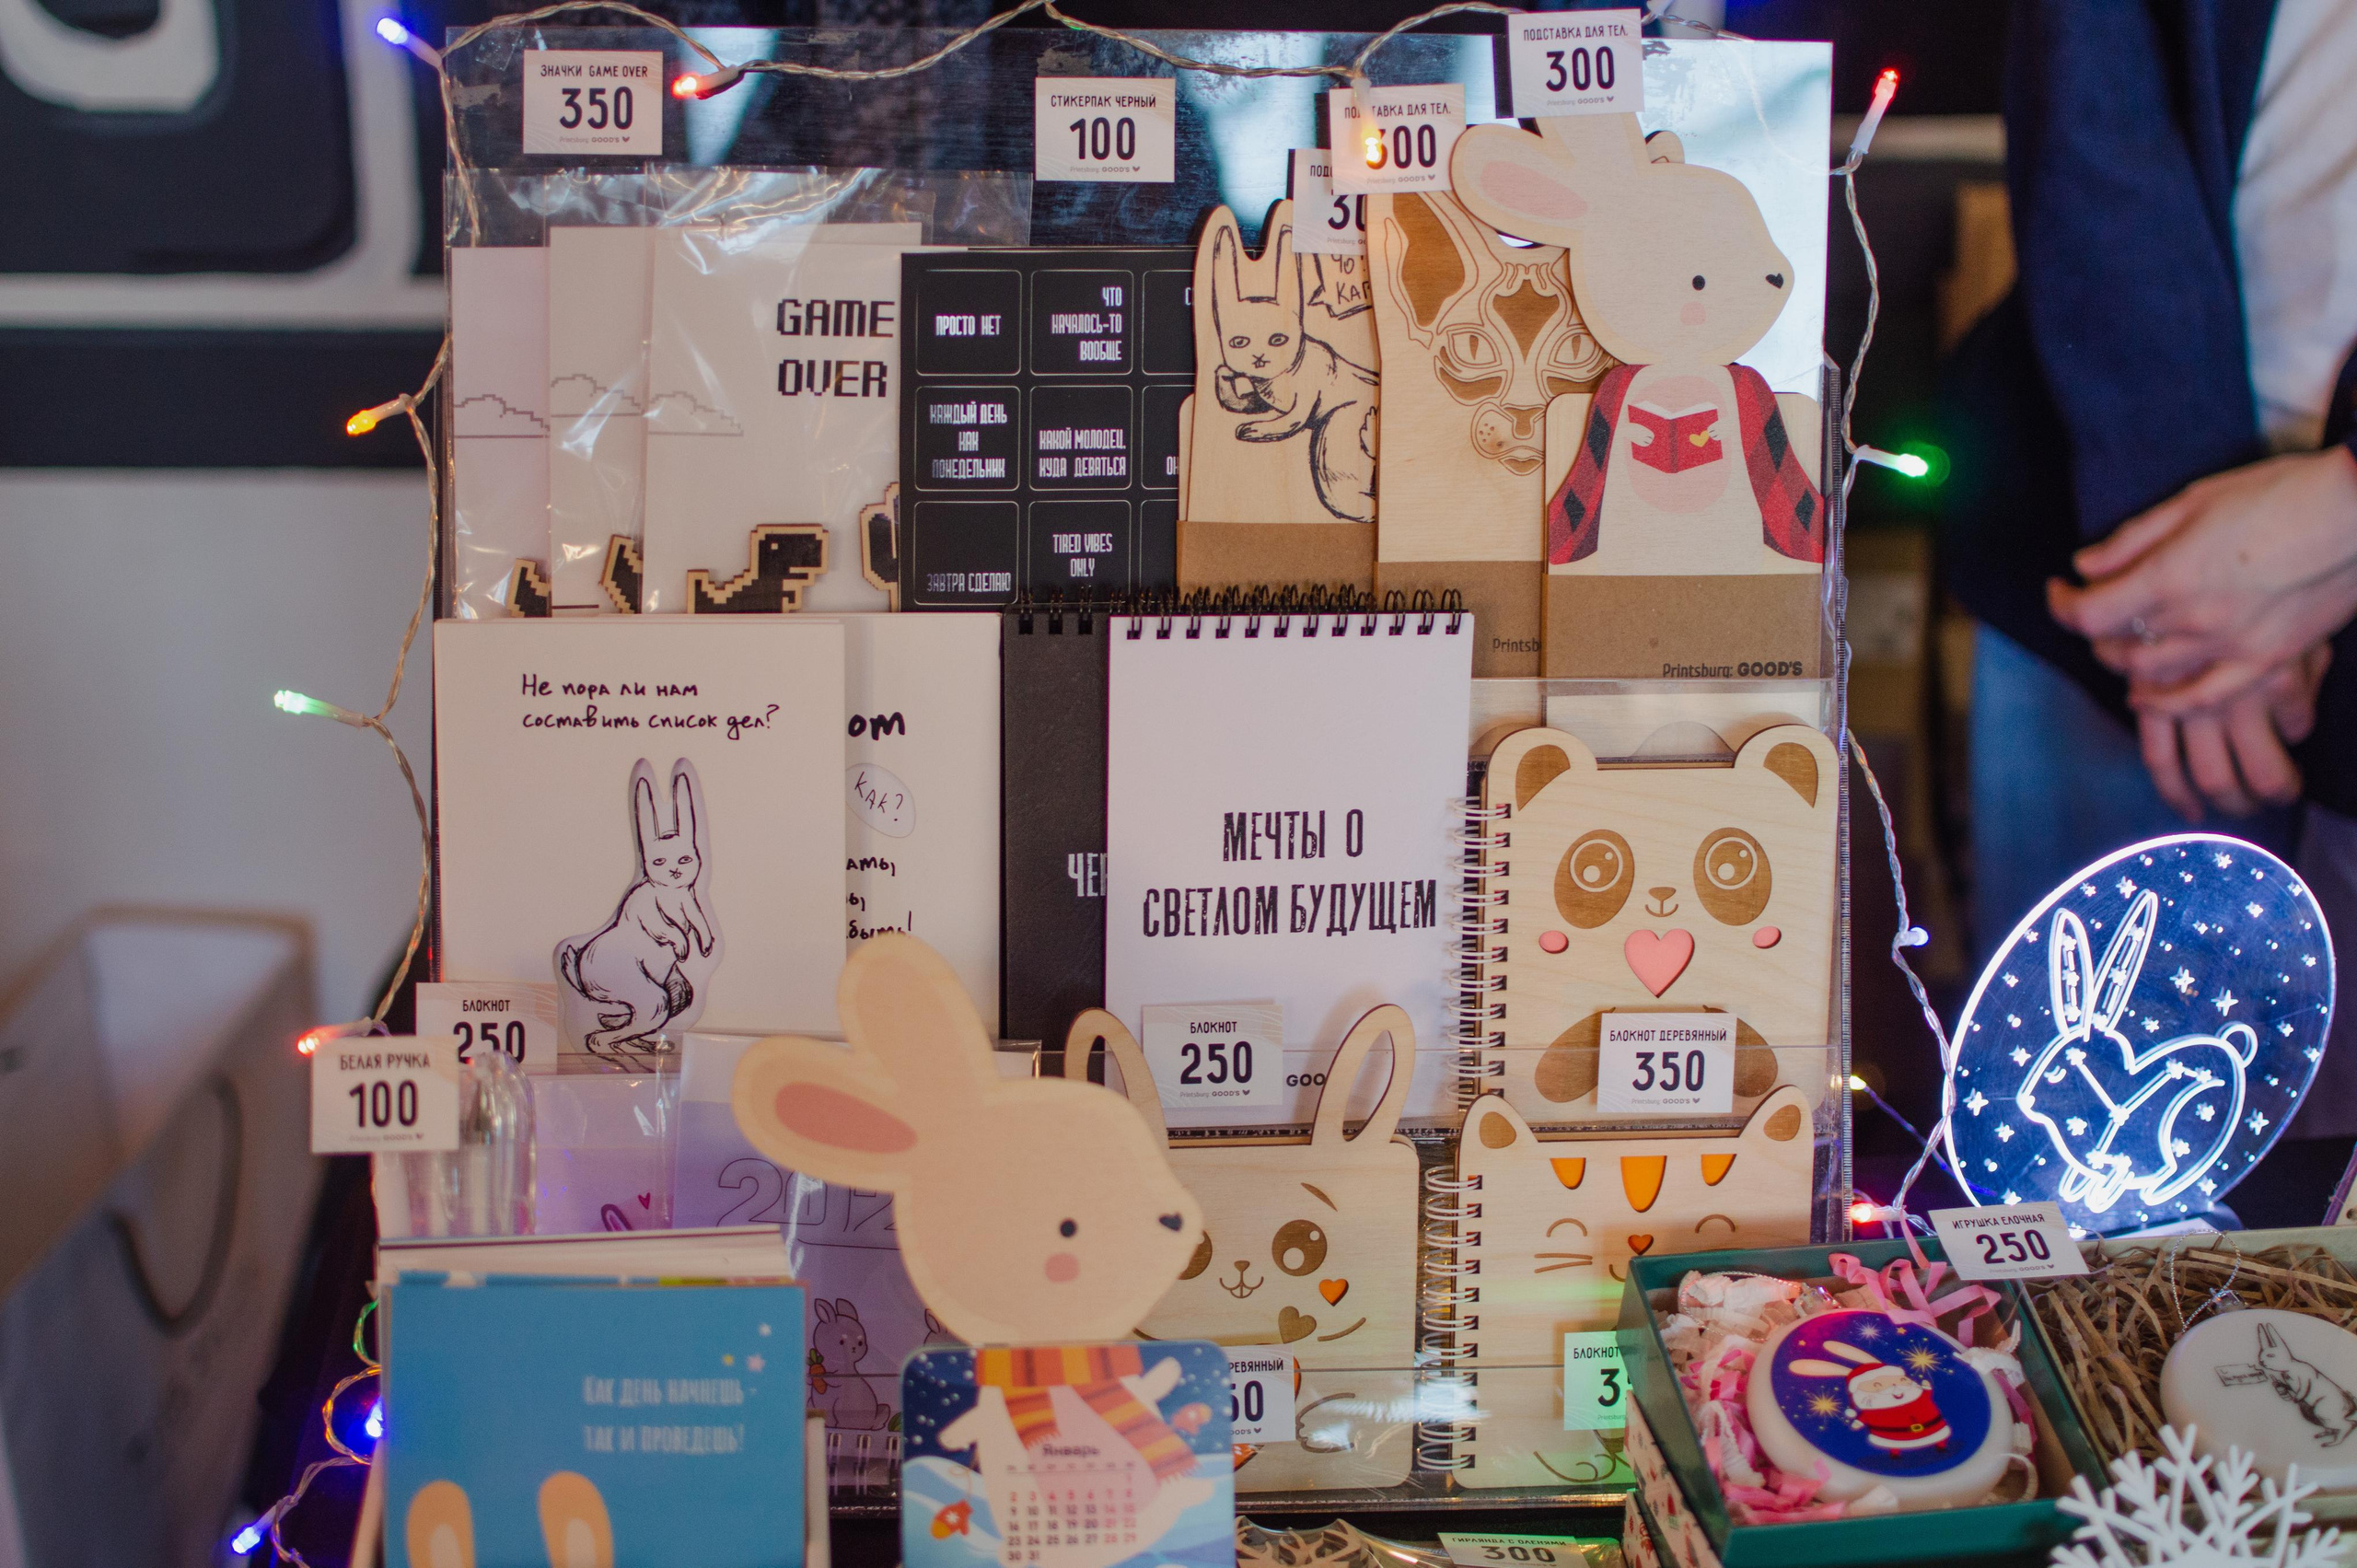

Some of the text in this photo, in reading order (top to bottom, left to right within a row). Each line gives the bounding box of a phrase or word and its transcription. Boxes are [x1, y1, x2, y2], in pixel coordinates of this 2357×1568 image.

[1524, 24, 1629, 41] ПОДСТАВКА ДЛЯ ТЕЛ.
[540, 64, 648, 77] ЗНАЧКИ GAME OVER
[1546, 46, 1615, 92] 300
[559, 86, 633, 130] 350
[1051, 94, 1156, 108] СТИКЕРПАК ЧЕРНЫЙ
[1407, 103, 1427, 116] ДЛЯ
[1430, 102, 1452, 115] ТЕЛ.
[1069, 116, 1136, 161] 100
[1398, 175, 1426, 183] GOOD'S
[1102, 286, 1123, 307] ЧТО
[777, 298, 895, 338] GAME
[935, 314, 1002, 336] ПРОСТО НЕТ
[1051, 313, 1123, 334] НАЧАЛОСЬ-ТО
[1080, 340, 1123, 361] ВООБЩЕ
[777, 359, 888, 398] OVER
[930, 401, 1008, 424] КАЖДЫЙ ДЕНЬ
[958, 431, 979, 451] КАК
[1039, 427, 1072, 450] КАКОЙ
[932, 459, 1005, 479] ПОНЕДЕЛЬНИК
[1039, 457, 1126, 478] КУДА ДЕВАТЬСЯ
[1052, 533, 1113, 553] TIRED VIBES
[1070, 558, 1096, 577] ONLY
[926, 572, 1012, 593] ЗАВТРА СДЕЛАЮ
[1737, 661, 1804, 677] GOOD'S
[522, 673, 699, 700] Не пора ли нам
[522, 703, 781, 740] составить список дел?
[1223, 808, 1364, 862] МЕЧТЫ О
[1143, 879, 1436, 937] СВЕТЛОМ БУДУЩЕМ
[462, 1000, 511, 1012] БЛОКНОТ
[1190, 1021, 1237, 1034] БЛОКНОТ
[1609, 1028, 1727, 1041] БЛОКНОТ ДЕРЕВЯННЫЙ
[453, 1020, 526, 1065] 250
[340, 1051, 431, 1070] БЕЛАЯ РУЧКА
[1180, 1040, 1253, 1085] 250
[1632, 1050, 1705, 1091] 350
[349, 1079, 419, 1128] 100
[1952, 1214, 2046, 1229] ИГРУШКА ЕЛОЧНАЯ
[1976, 1229, 2050, 1264] 250
[1573, 1345, 1621, 1360] БЛОКНОТ
[584, 1376, 614, 1405] КАК
[619, 1378, 662, 1407] ДЕНЬ
[668, 1378, 744, 1406] НАЧНЕШЬ
[1598, 1368, 1631, 1408] 3
[585, 1423, 745, 1455] ТАК И ПРОВЕДЕШЬ!
[1042, 1443, 1101, 1458] Январь
[1480, 1545, 1556, 1562] 300
